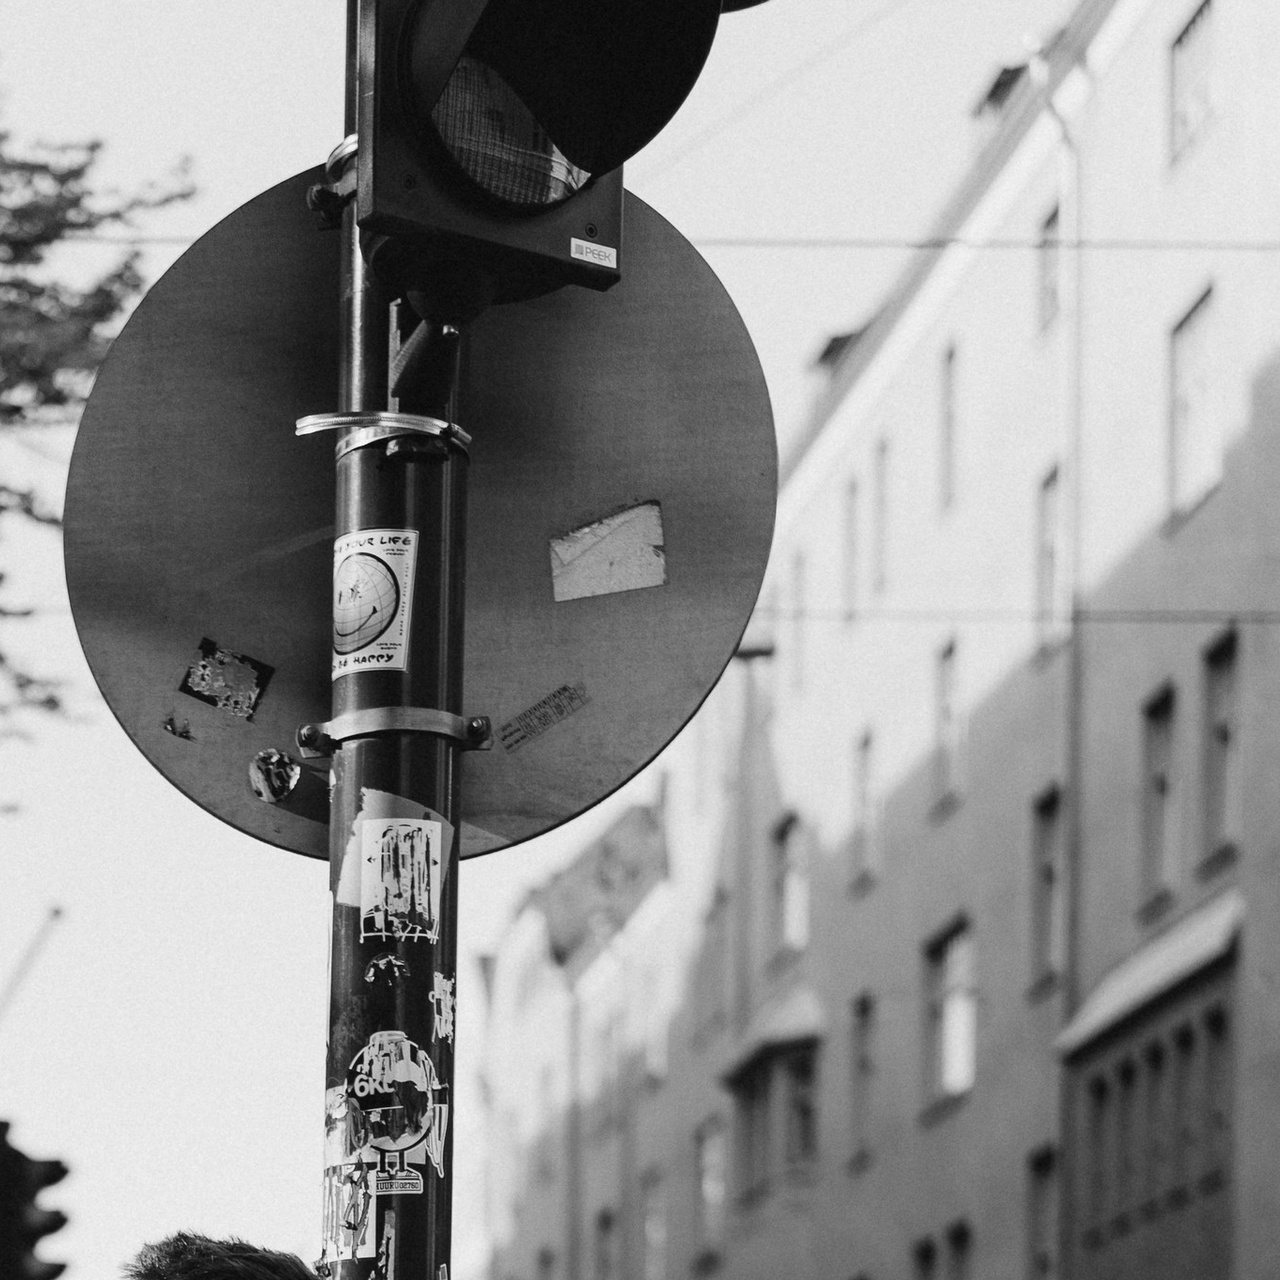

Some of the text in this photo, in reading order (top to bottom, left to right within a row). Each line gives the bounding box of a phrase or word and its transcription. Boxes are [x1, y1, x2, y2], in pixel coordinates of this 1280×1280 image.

[584, 246, 612, 264] PEEK
[380, 536, 412, 546] LIFE
[353, 653, 395, 664] HAPPY
